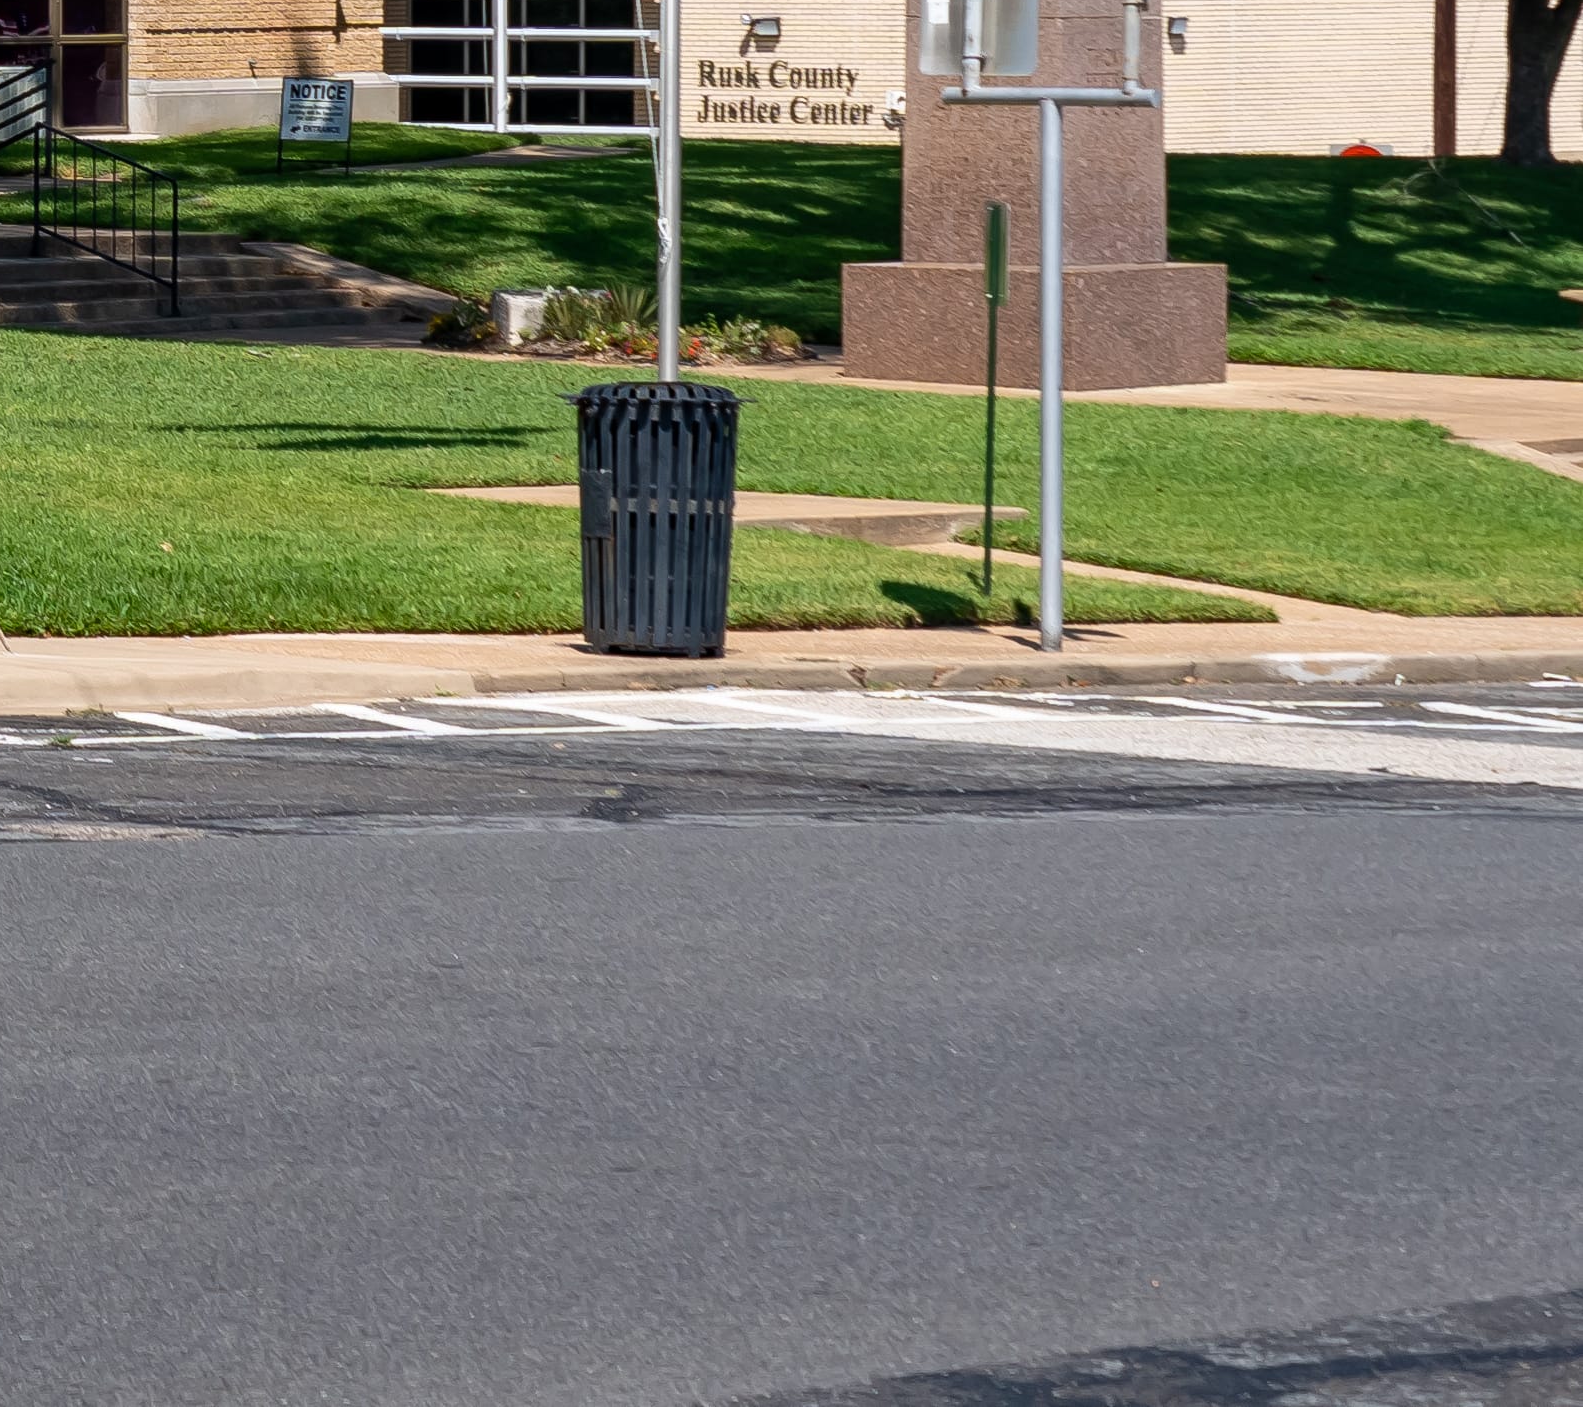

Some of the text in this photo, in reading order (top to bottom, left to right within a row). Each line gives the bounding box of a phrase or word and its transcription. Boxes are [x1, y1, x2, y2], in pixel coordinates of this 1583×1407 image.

[698, 59, 860, 96] Rusk County
[290, 83, 347, 100] NOTICE
[697, 94, 875, 126] Justice Center
[303, 125, 340, 134] ENTRANCE
